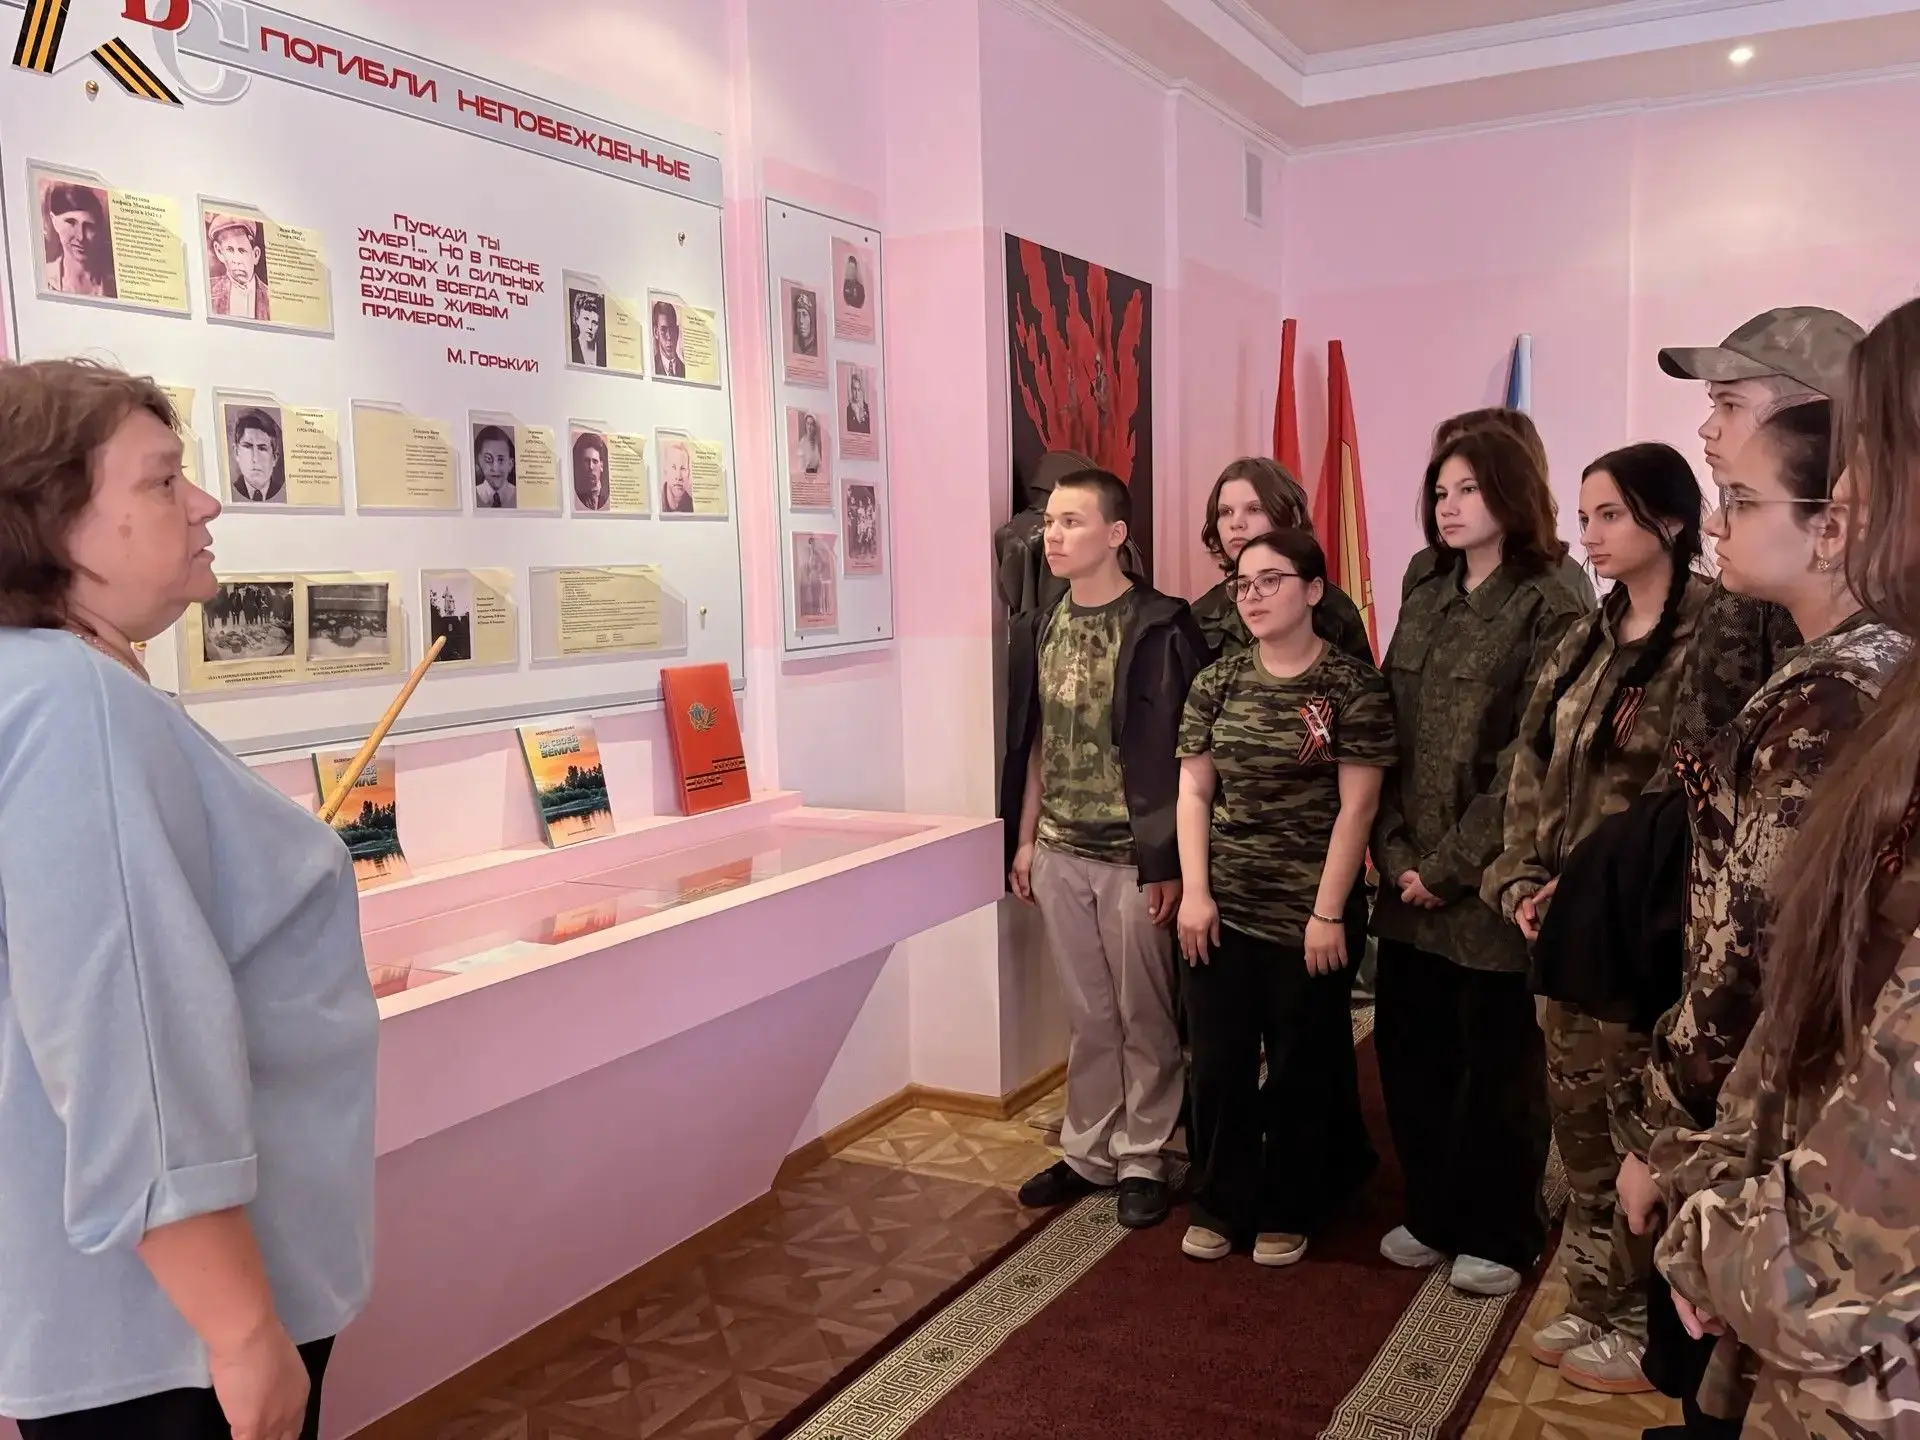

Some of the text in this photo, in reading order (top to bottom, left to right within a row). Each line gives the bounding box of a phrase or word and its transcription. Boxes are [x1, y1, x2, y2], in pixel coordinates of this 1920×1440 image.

[260, 26, 690, 182] ПОГИБЛИ НЕПОБЕЖДЕННЫЕ
[358, 247, 544, 293] СМЕЛЫХ И СИЛЬНЫХ
[490, 254, 540, 276] ПЕСНЕ
[360, 266, 528, 306] ДУХОМ ВСЕГДА ТЫ
[361, 284, 508, 319] БУДЕШЬ ЖИВЫМ
[541, 743, 580, 758] ЗЕМЛЕ
